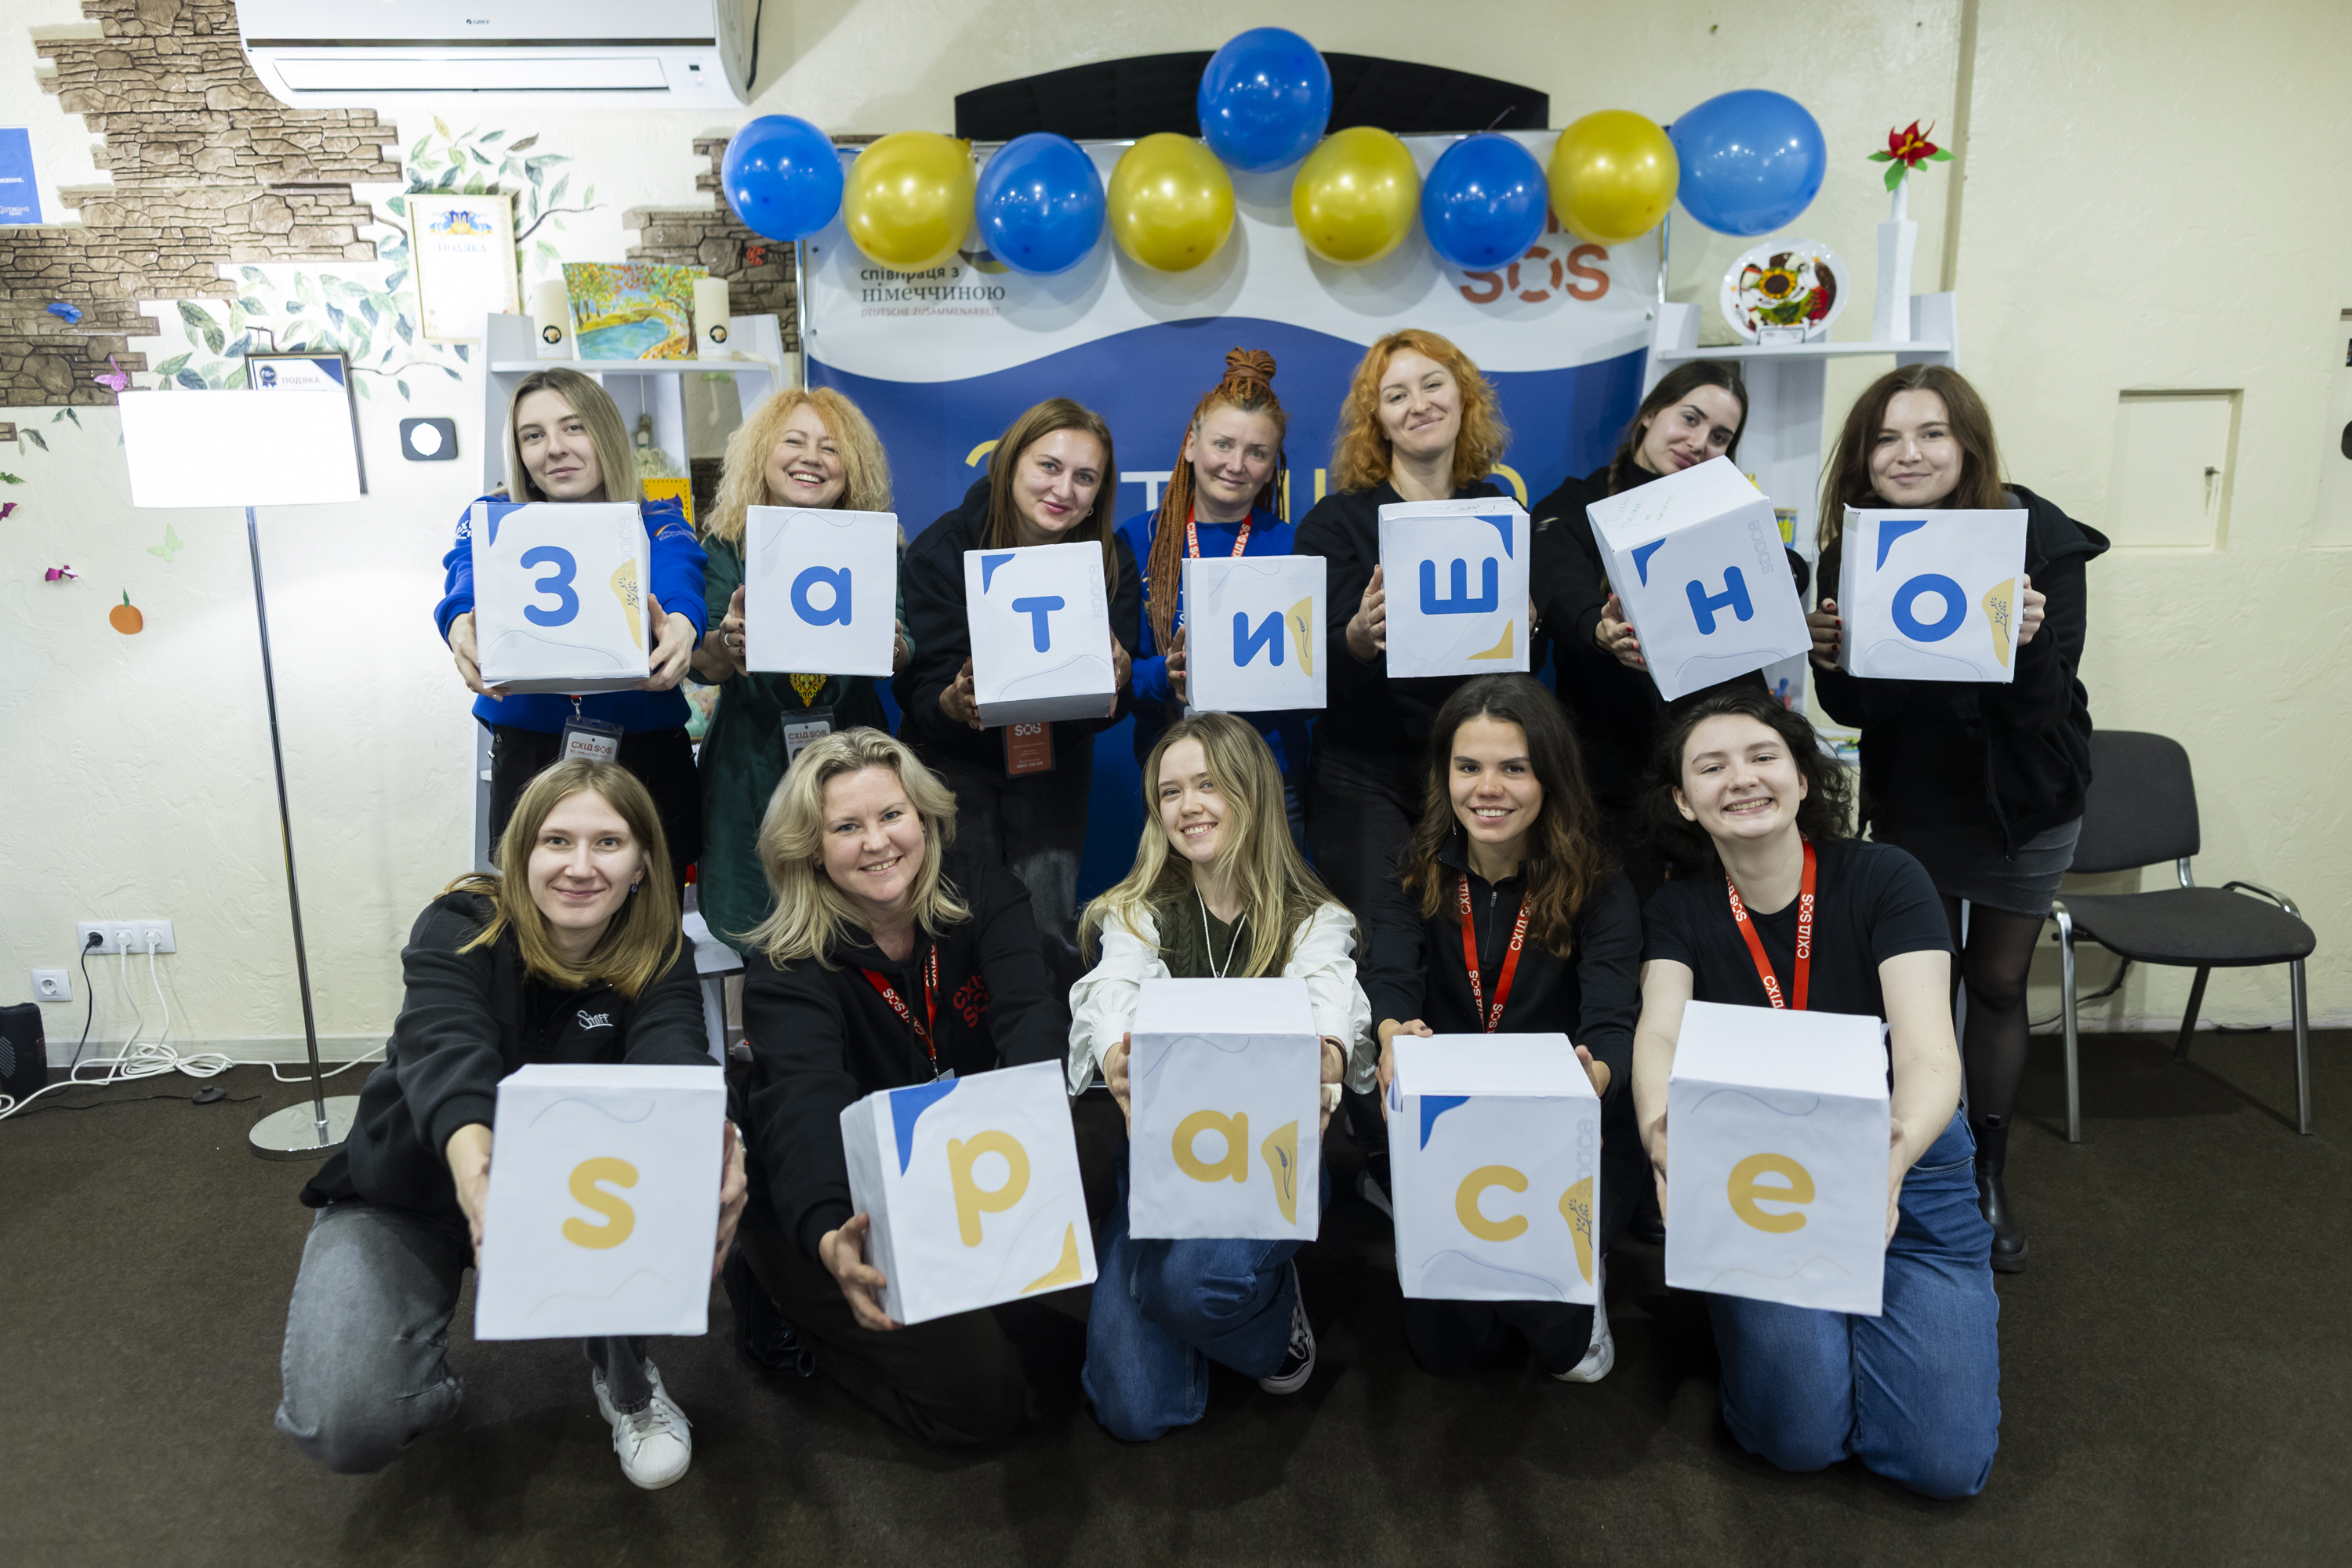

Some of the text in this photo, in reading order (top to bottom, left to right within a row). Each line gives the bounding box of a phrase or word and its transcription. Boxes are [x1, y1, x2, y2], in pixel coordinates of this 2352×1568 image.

[438, 244, 487, 252] ПОДЯКА
[1460, 244, 1610, 304] SOS
[862, 283, 1005, 303] німеччиною
[861, 307, 1000, 317] DEUTSCHE ZUSAMMENARBEIT
[282, 376, 320, 385] ПОДЯКА
[618, 515, 637, 581] space
[1748, 519, 1775, 575] space
[1088, 563, 1105, 619] space
[788, 729, 827, 740] СХІД SOS
[1014, 723, 1041, 736] SOS
[572, 741, 612, 754] СХІД SOS
[1459, 882, 1471, 915] СХІД
[1730, 894, 1748, 922] SOS
[1510, 919, 1528, 951] СХІД
[1797, 894, 1814, 960] СХІД SOS
[1468, 970, 1481, 996] SOS
[1763, 975, 1784, 1009] СХІД
[883, 988, 906, 1011] SOS
[964, 993, 990, 1028] SO
[1489, 1004, 1504, 1028] SOS
[1171, 1109, 1249, 1183] a
[1576, 1118, 1595, 1200] space
[946, 1130, 1030, 1247] p
[1727, 1152, 1815, 1233] e
